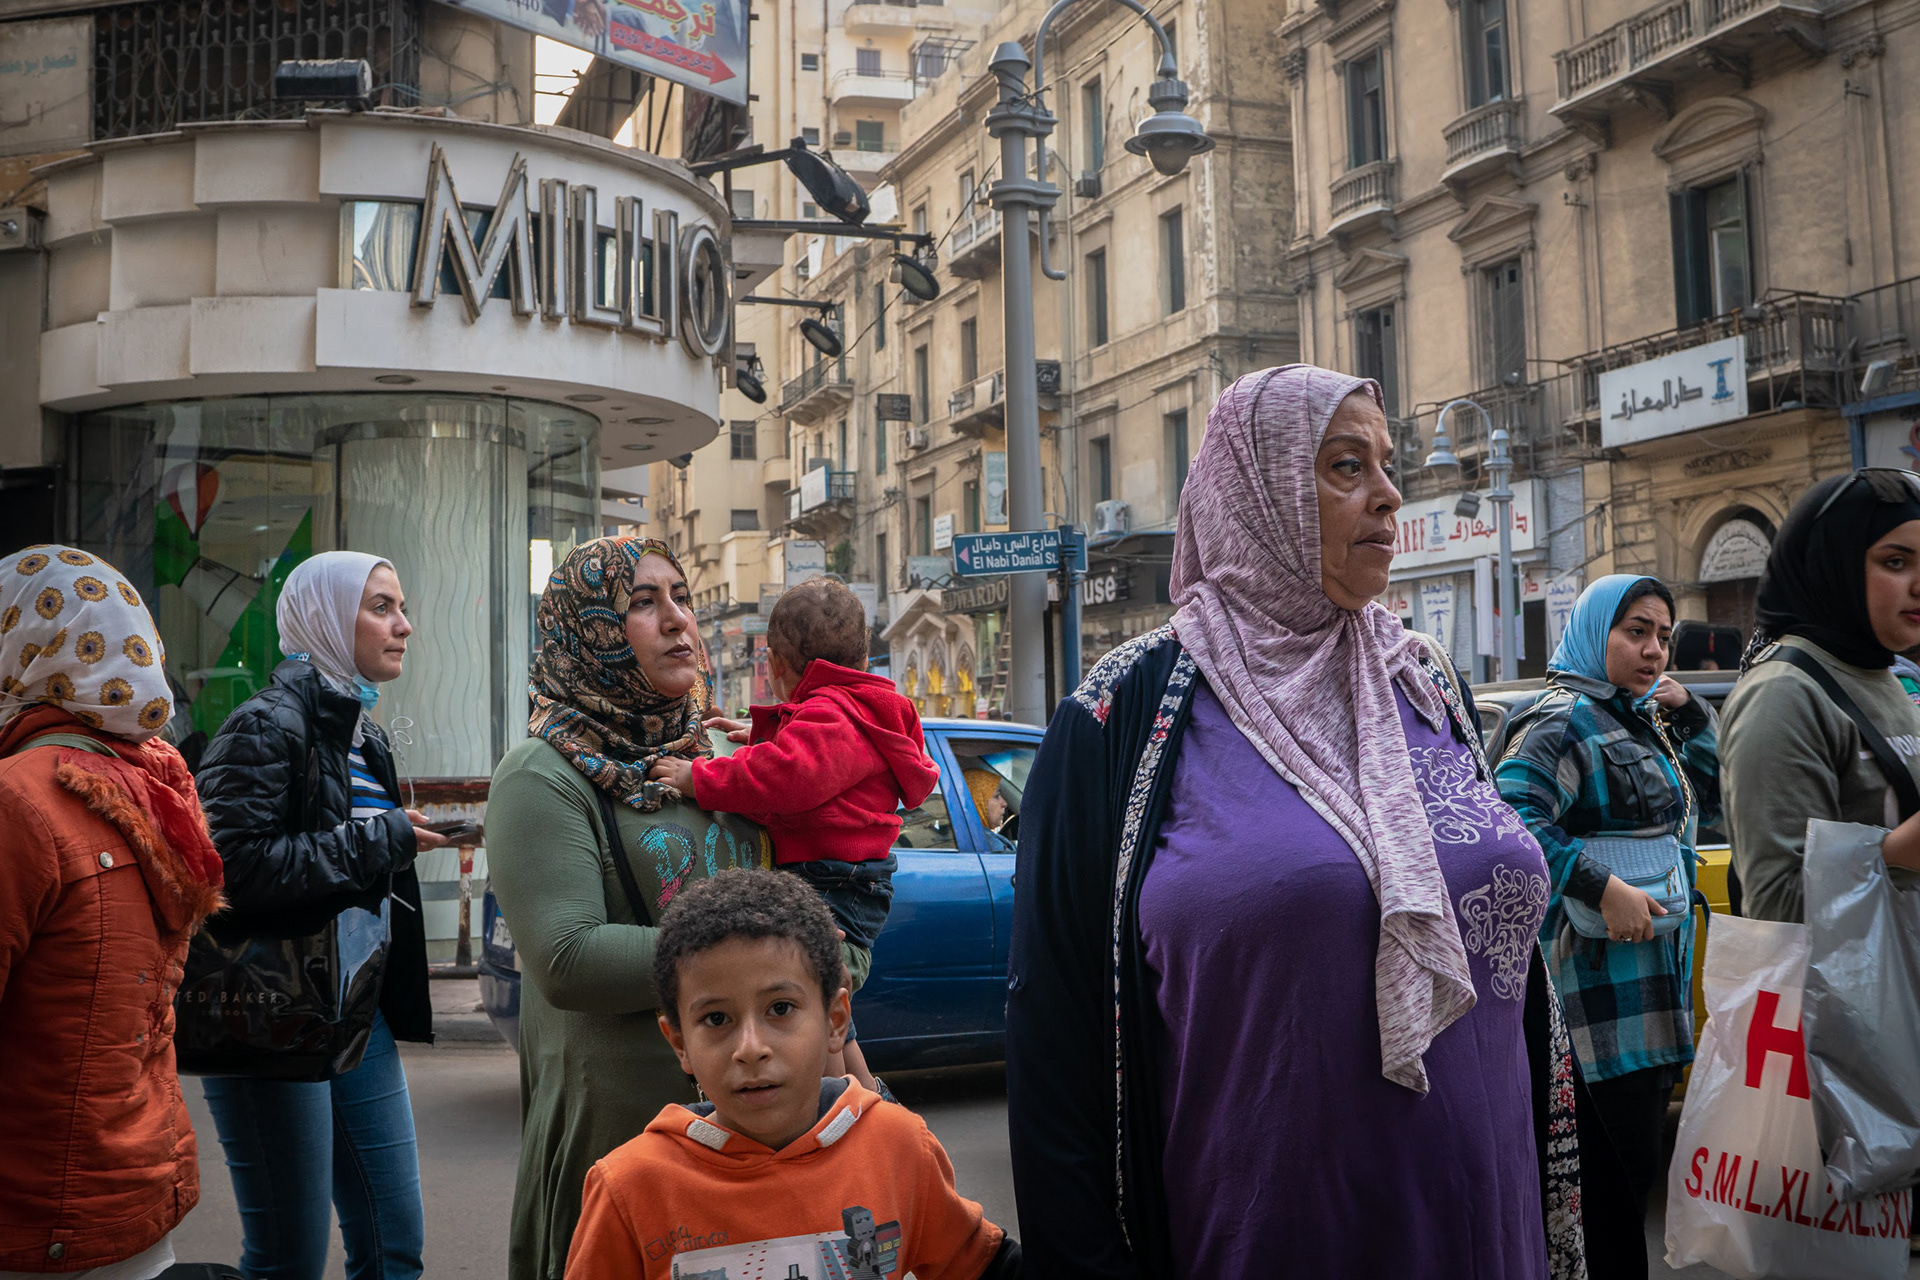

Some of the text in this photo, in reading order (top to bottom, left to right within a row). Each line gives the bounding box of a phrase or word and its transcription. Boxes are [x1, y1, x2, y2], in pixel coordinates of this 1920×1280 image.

[410, 141, 730, 359] MILLIO
[1671, 375, 1704, 410] دار
[972, 537, 1001, 554] دانيال
[1032, 534, 1058, 554] شارع
[1394, 517, 1425, 555] AREF
[973, 552, 1059, 569] El Nabi Danial St.
[1081, 574, 1117, 605] use
[221, 991, 278, 1004] BAKER
